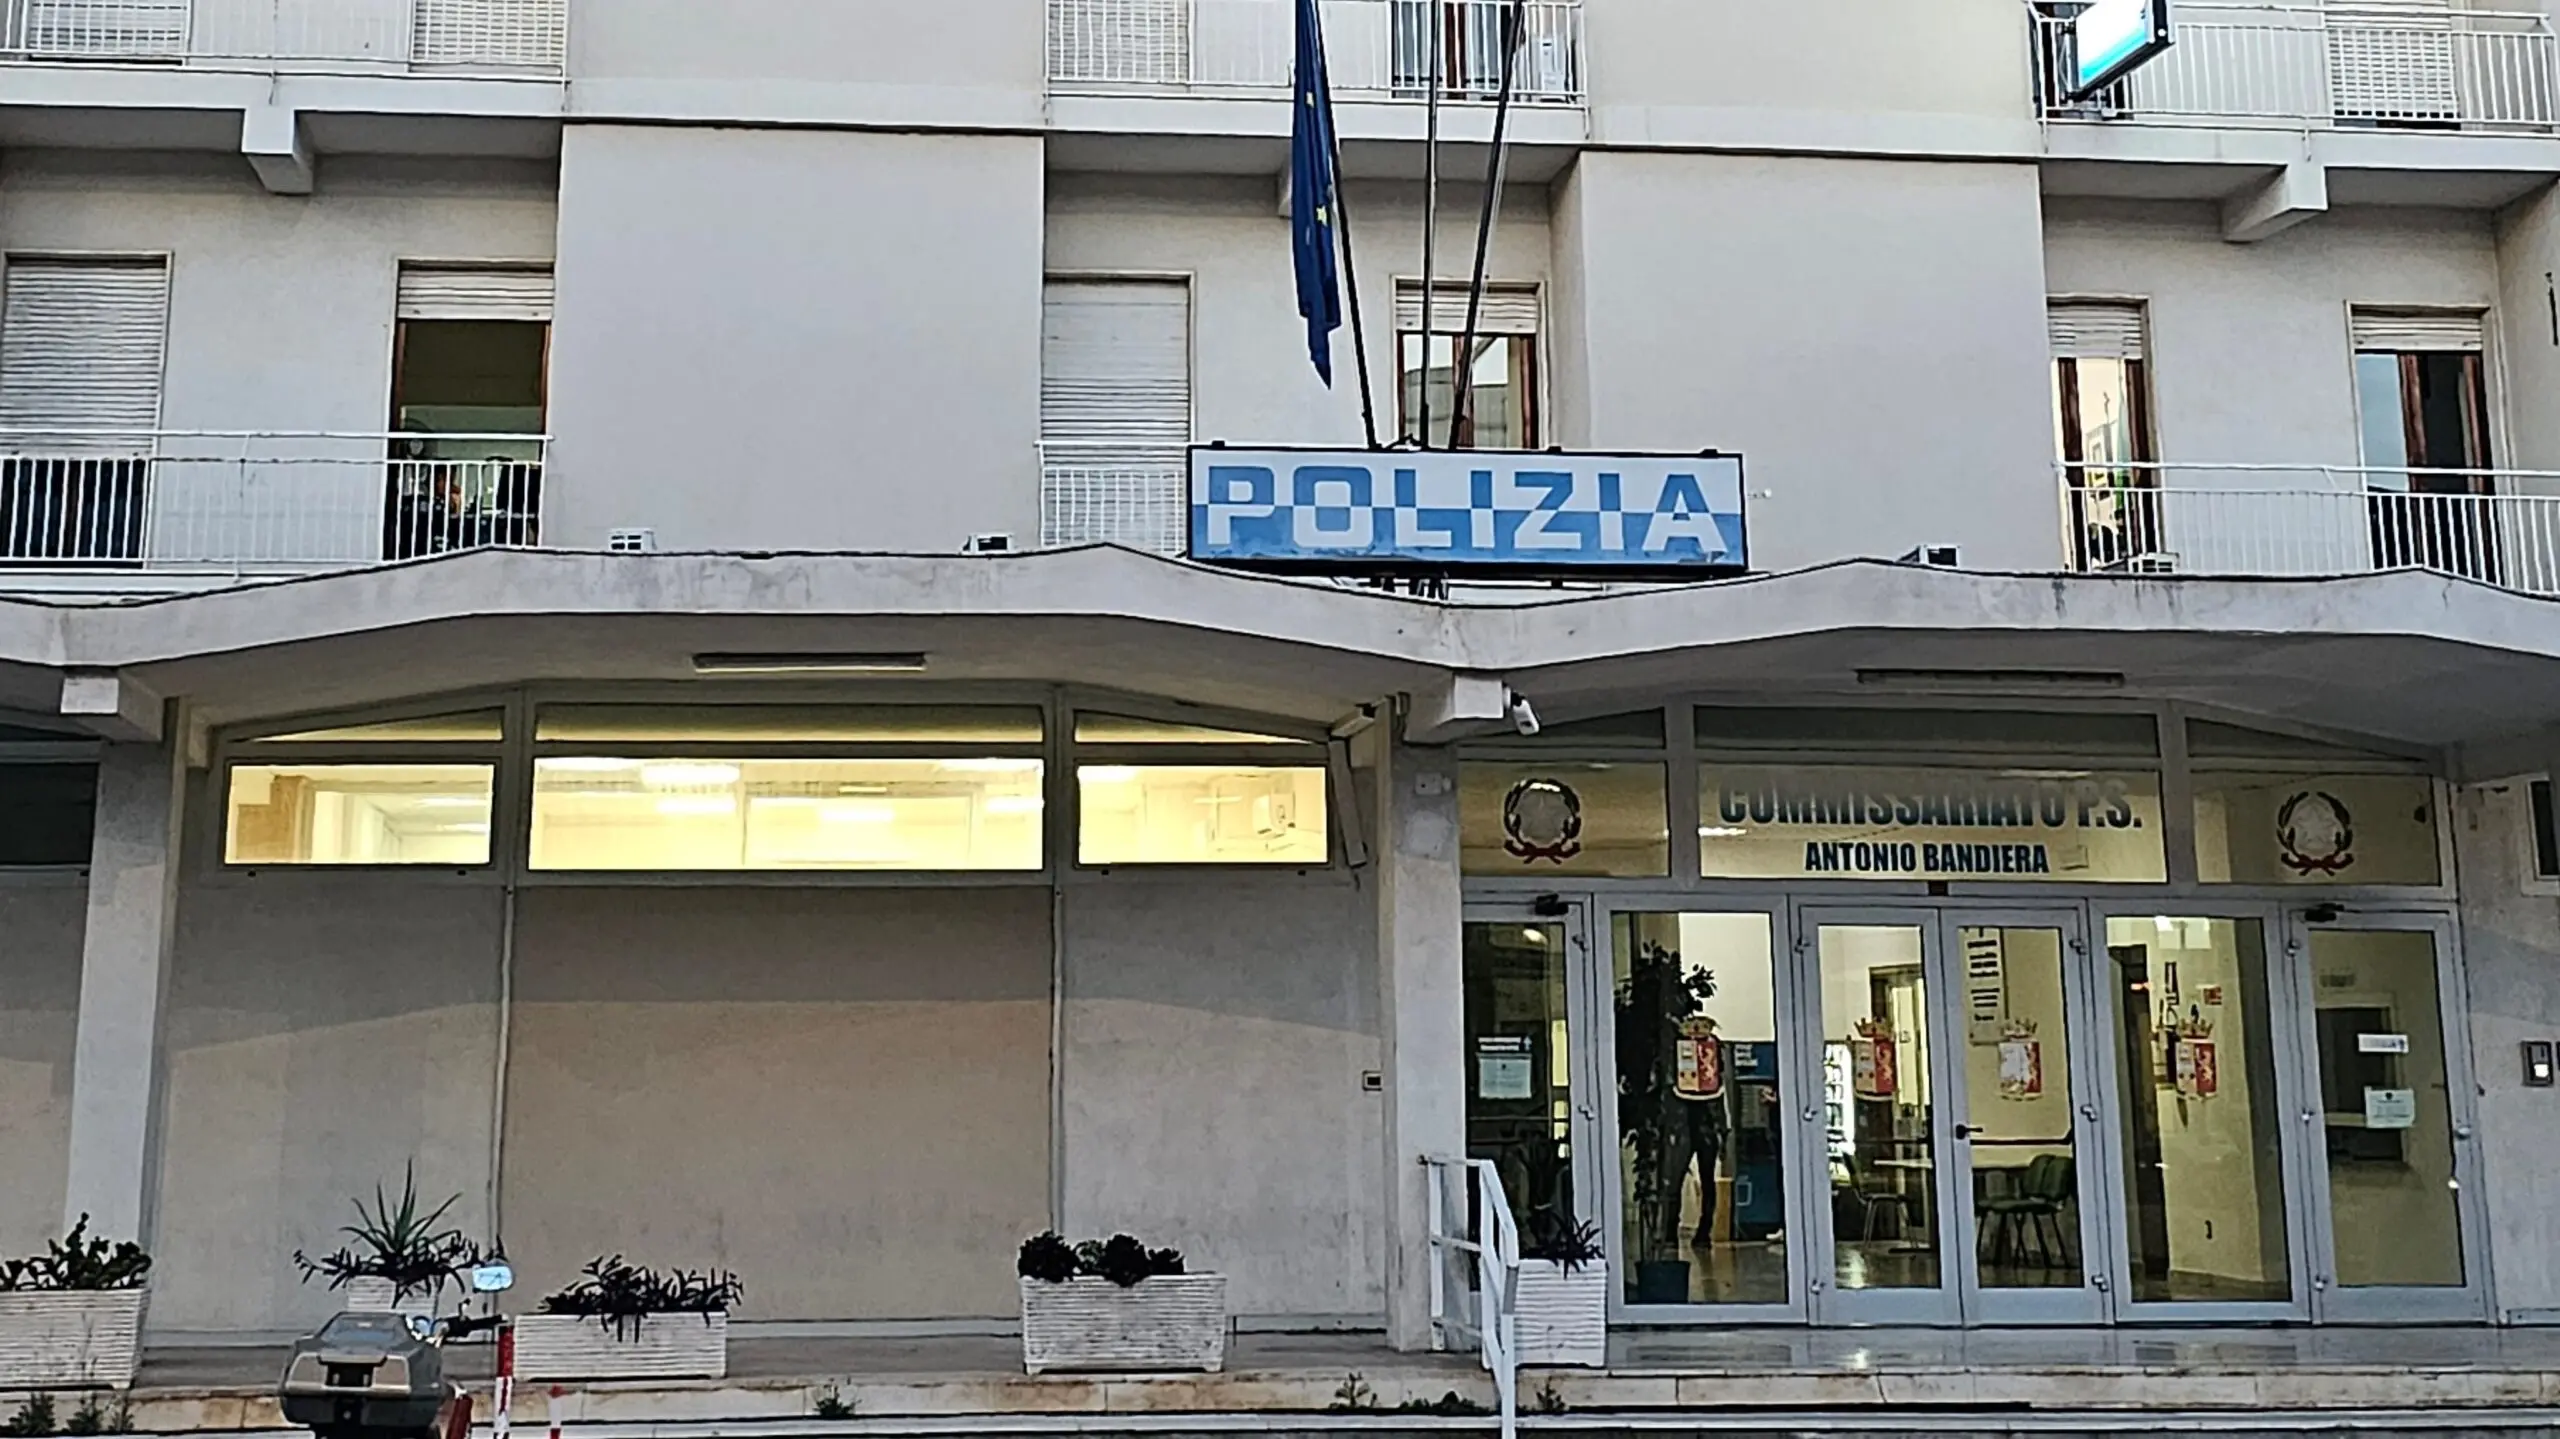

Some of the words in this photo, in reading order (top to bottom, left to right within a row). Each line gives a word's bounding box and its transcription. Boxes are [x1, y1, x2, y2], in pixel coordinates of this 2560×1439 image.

[1207, 465, 1727, 553] POLIZIA
[1718, 777, 2067, 827] COMMISSARIATO
[2077, 779, 2143, 828] P.S.
[1805, 842, 1916, 872] ANTONIO
[1923, 844, 2050, 873] BANDIERA
